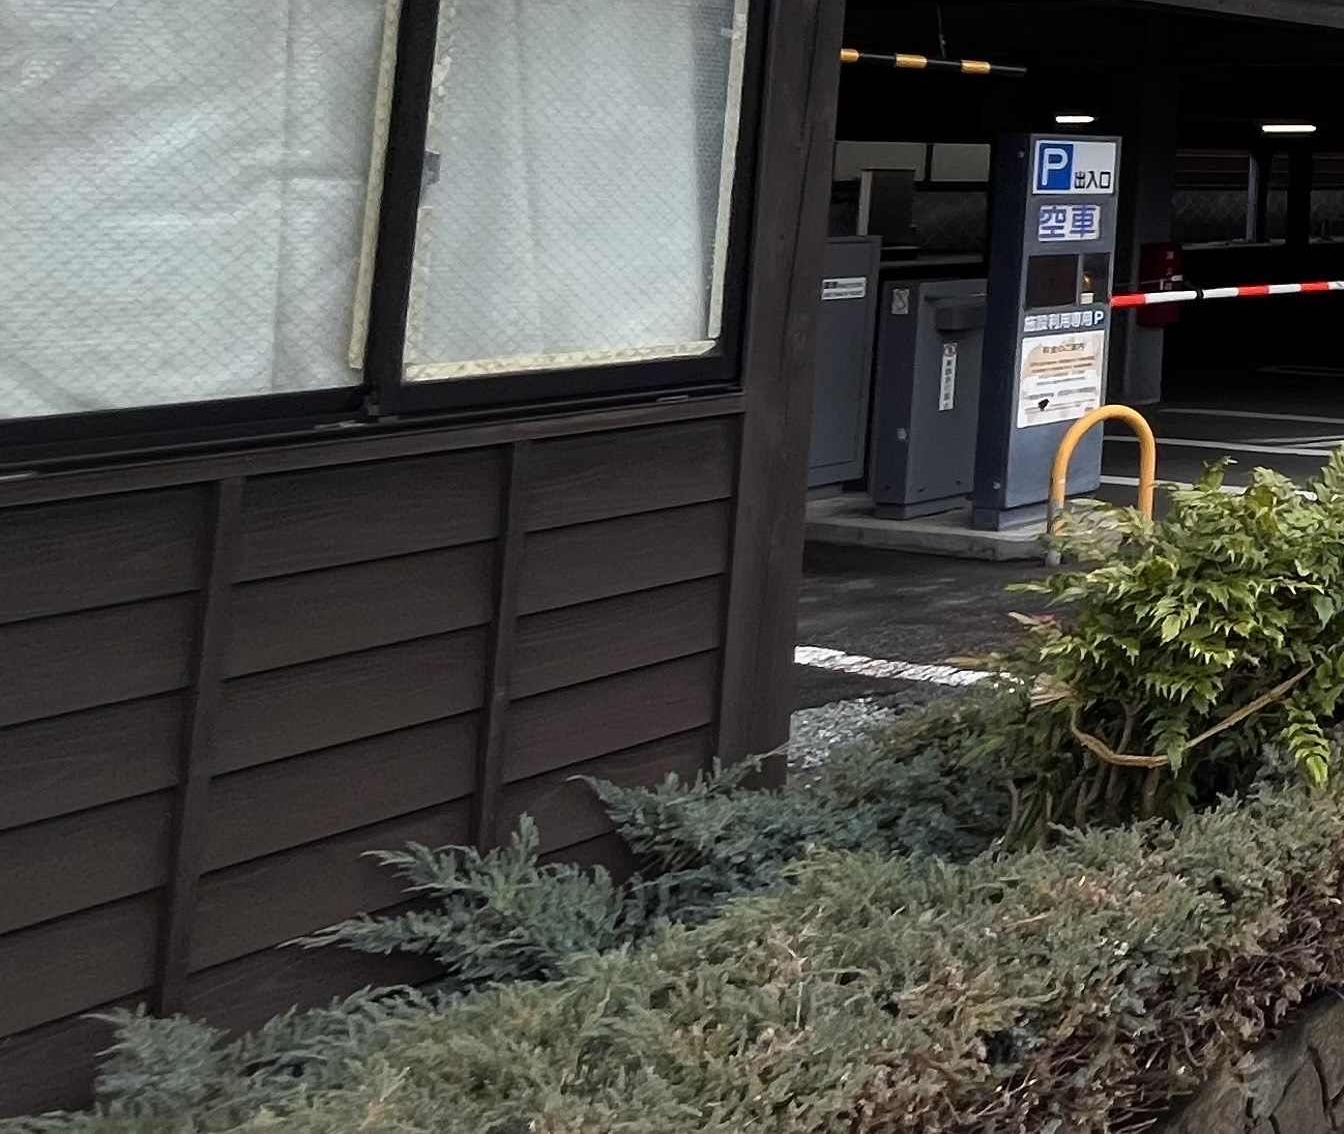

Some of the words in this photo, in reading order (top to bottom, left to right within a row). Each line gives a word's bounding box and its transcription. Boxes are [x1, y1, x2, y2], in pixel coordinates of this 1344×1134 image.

[1074, 170, 1111, 189] 出入口
[1039, 205, 1097, 239] 空車
